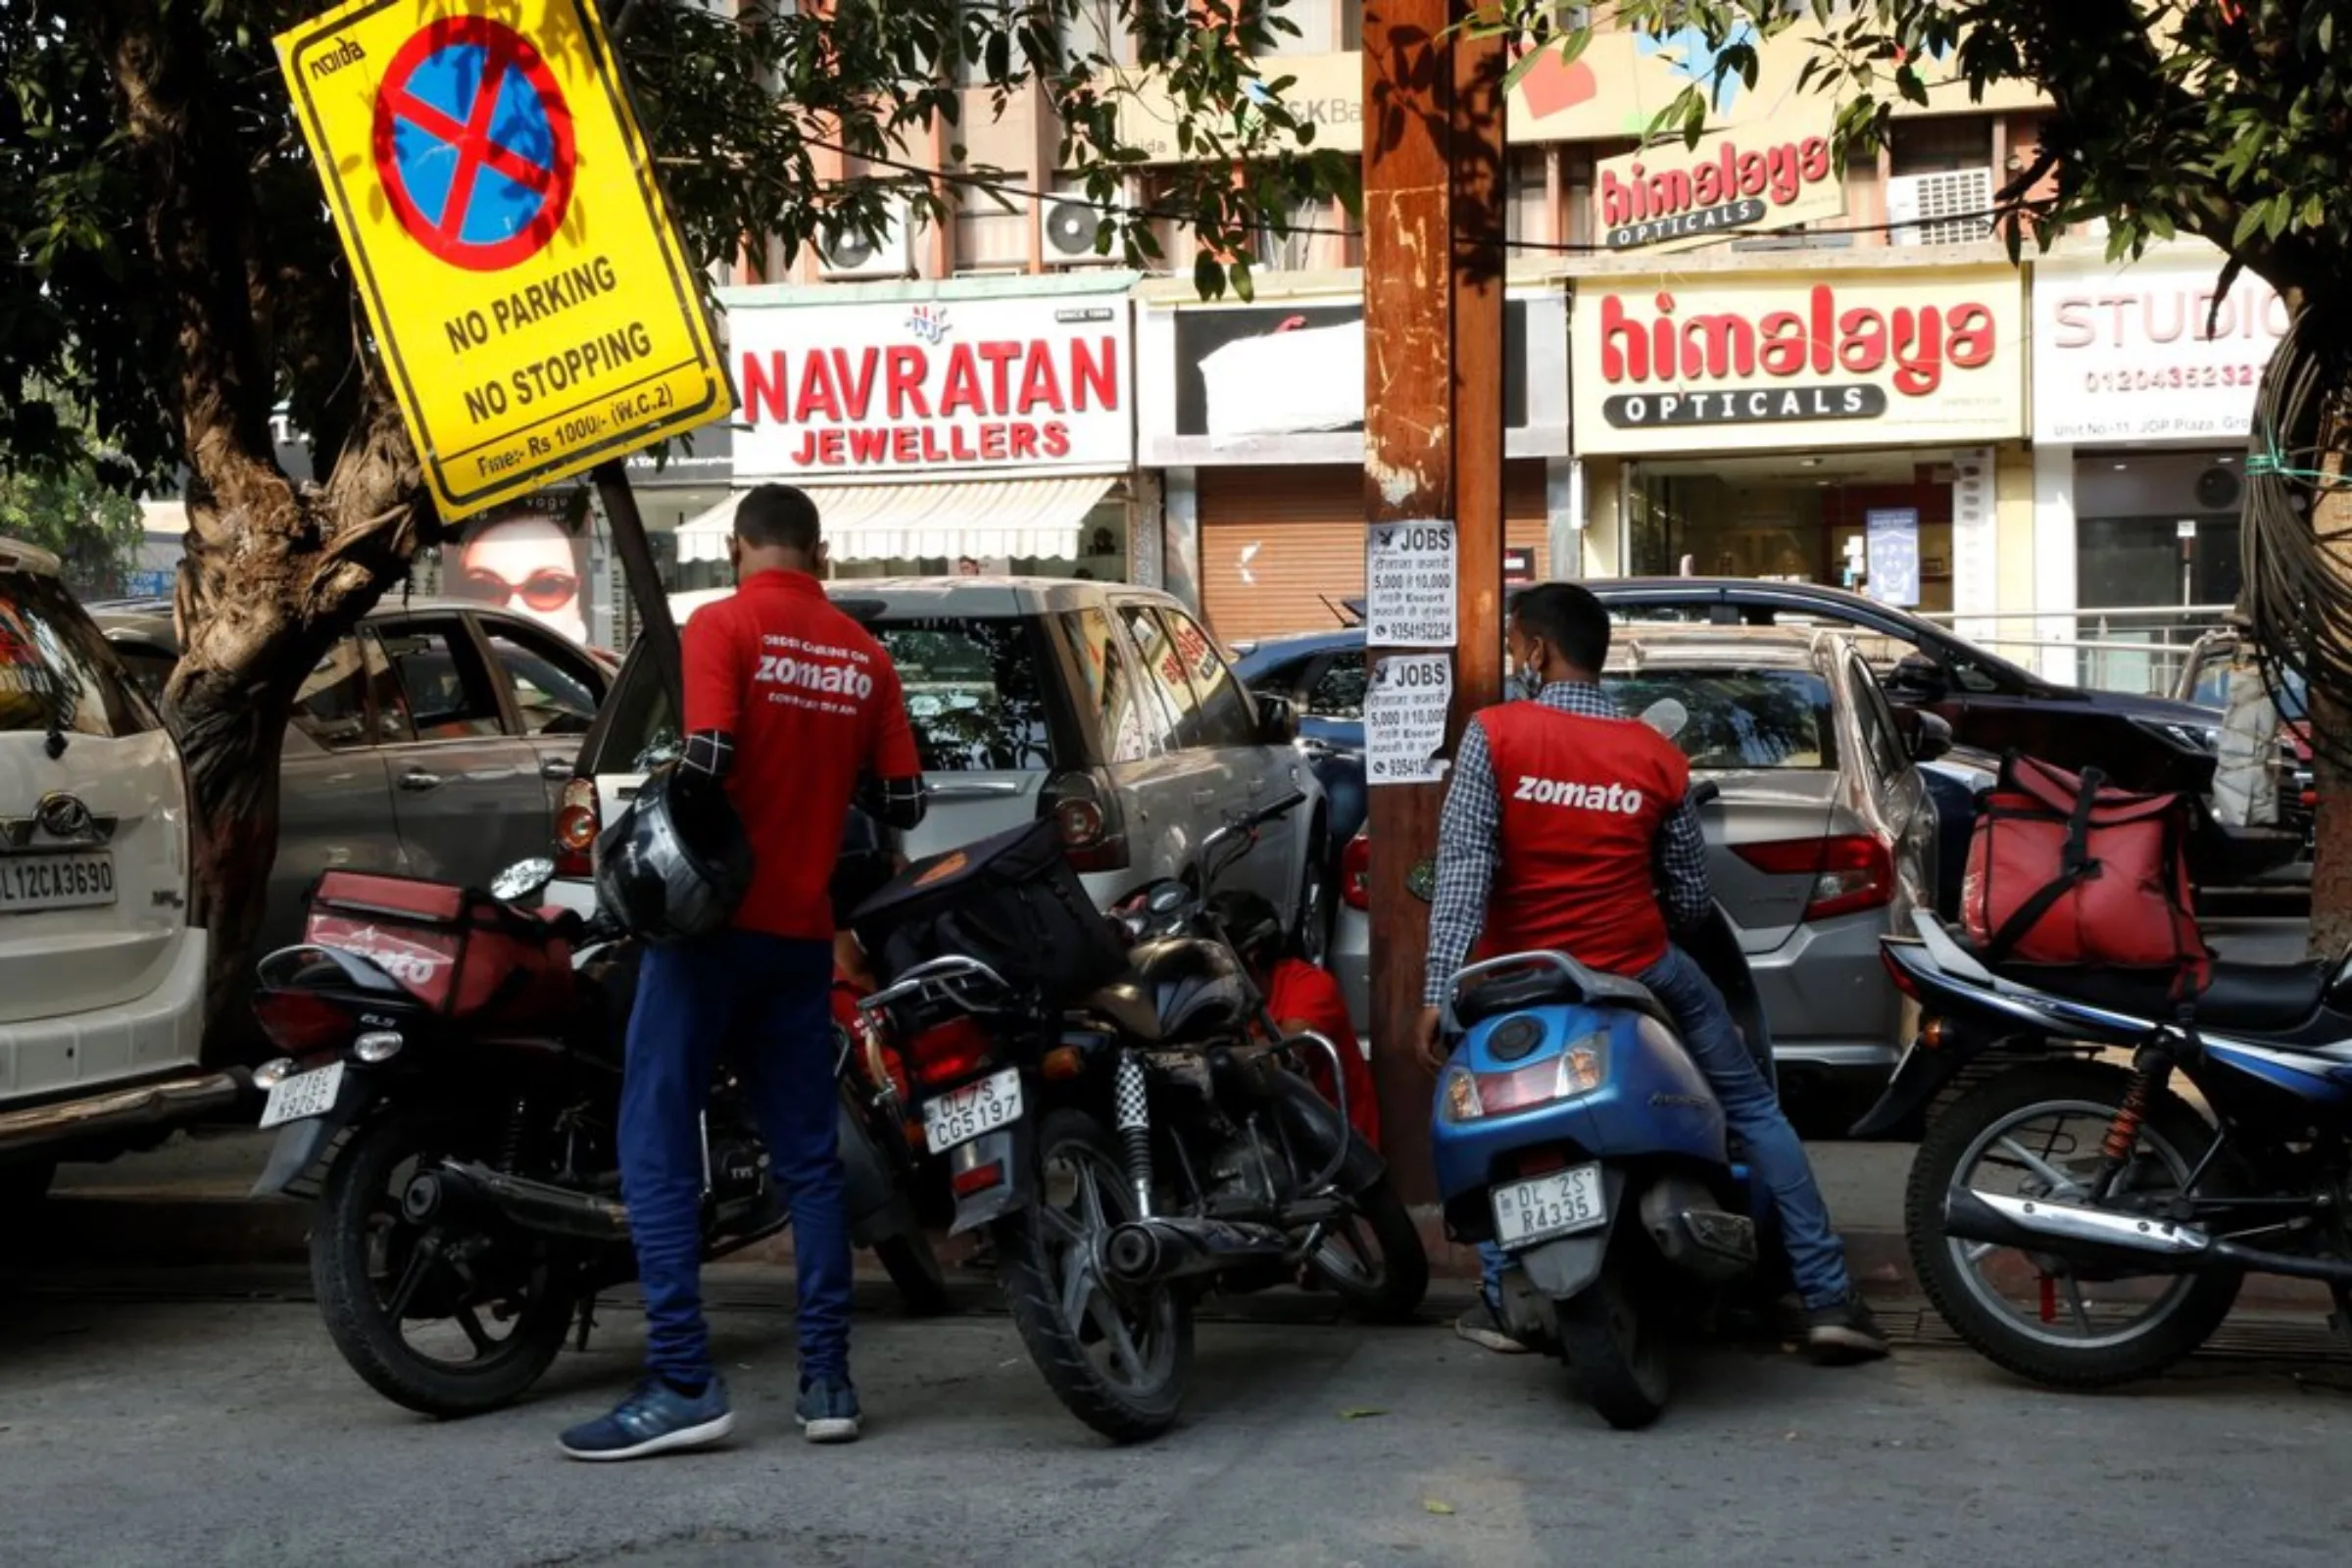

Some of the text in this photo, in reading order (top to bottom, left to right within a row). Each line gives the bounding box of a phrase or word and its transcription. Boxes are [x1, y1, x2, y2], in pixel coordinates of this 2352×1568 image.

[1601, 136, 1831, 228] himalaya
[1618, 202, 1752, 245] OPTICALS
[444, 256, 616, 355] NO PARKING
[1601, 283, 1996, 397] himalaya
[464, 321, 652, 424] NO STOPPING
[742, 337, 1119, 423] NAVRATAN
[1625, 388, 1864, 421] OPTICALS
[527, 437, 551, 458] Rs
[791, 420, 1070, 466] JEWELLERS
[1400, 528, 1450, 552] JOBS
[755, 655, 873, 700] zomato
[1395, 662, 1446, 687] JOBS
[1514, 775, 1643, 815] zomato
[0, 861, 113, 900] L12CA3690
